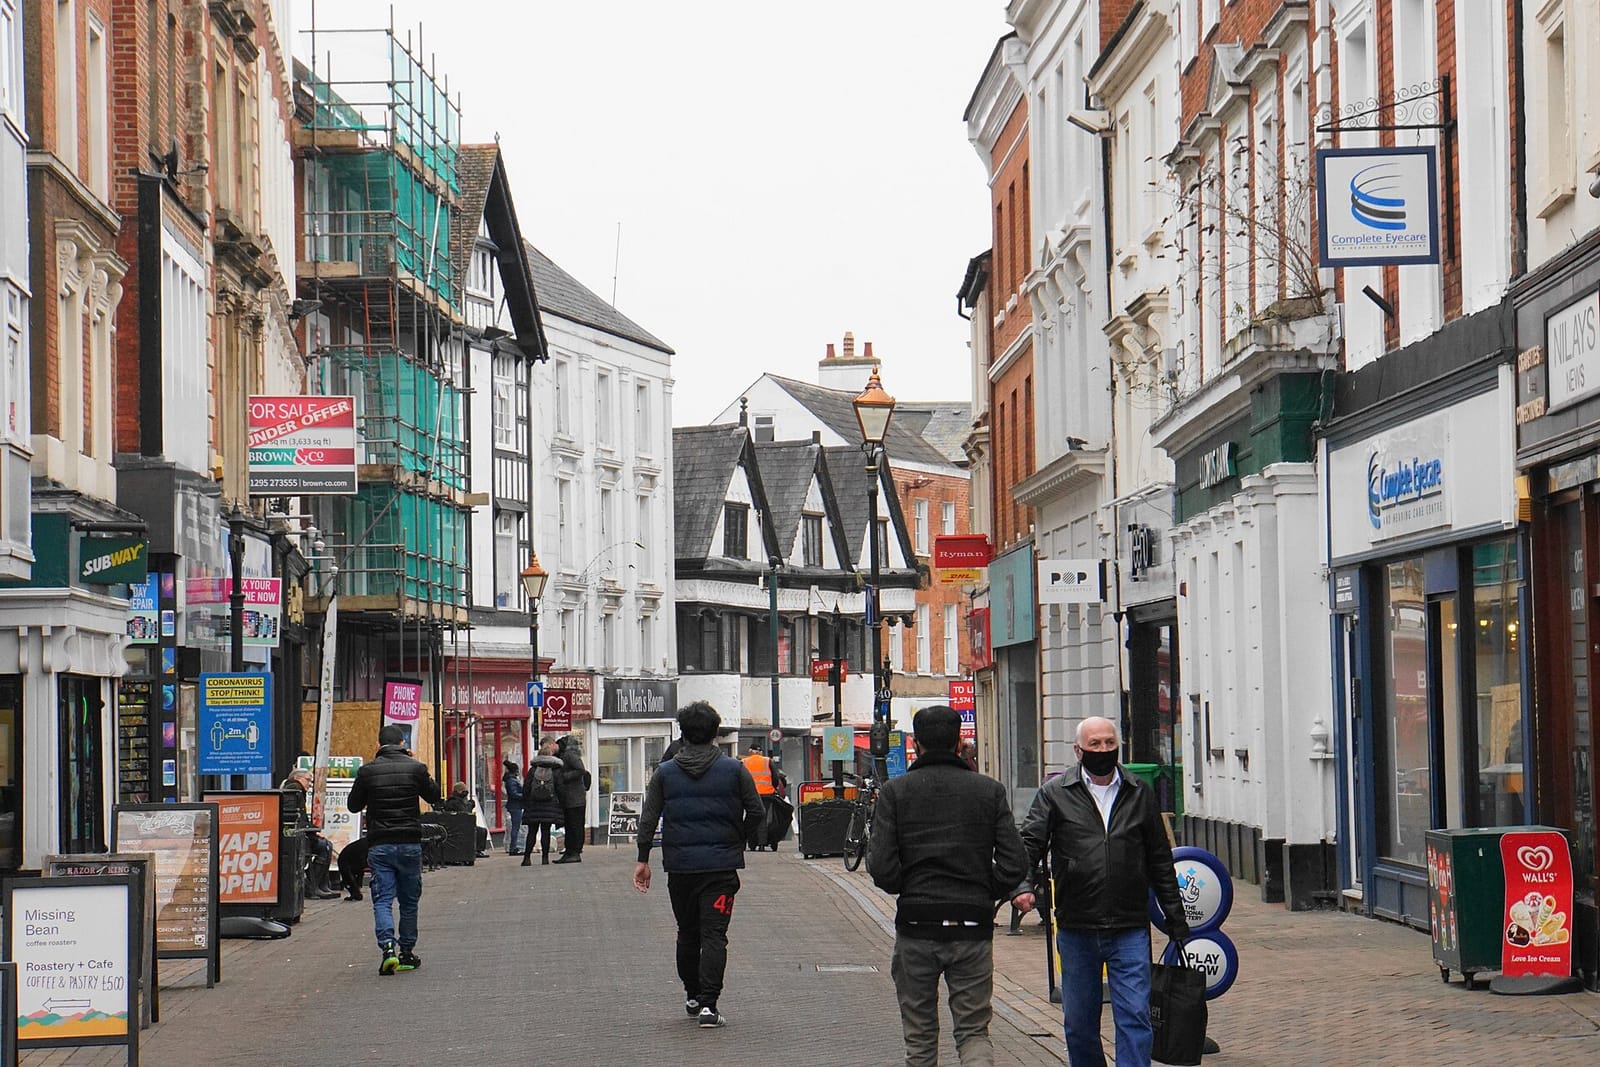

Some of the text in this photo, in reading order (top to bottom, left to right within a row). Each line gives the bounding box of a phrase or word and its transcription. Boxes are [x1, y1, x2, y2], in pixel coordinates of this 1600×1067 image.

[1331, 233, 1427, 244] Complete Eyecare
[1553, 306, 1596, 368] NILAYS
[1566, 363, 1586, 394] NEWS
[279, 403, 317, 419] SALE
[248, 400, 350, 447] UNDER OFFER
[270, 479, 298, 487] 273555
[1380, 457, 1442, 505] Complete Eyecare
[82, 543, 145, 577] SUBWAY
[939, 551, 984, 559] Ryman
[1051, 571, 1088, 584] POP
[133, 586, 147, 597] DAY
[250, 580, 271, 590] YOUR
[257, 591, 276, 602] NOW
[393, 685, 416, 700] PHONE
[473, 686, 491, 705] Heart
[491, 686, 525, 705] Foundation
[616, 688, 628, 713] The
[647, 689, 665, 712] Room
[389, 701, 417, 717] REPAIRS
[305, 757, 354, 767] W'RE
[222, 806, 241, 814] NEW
[242, 812, 261, 820] YOU
[220, 831, 271, 851] VAPE
[220, 853, 273, 873] HOP
[107, 866, 129, 874] KING
[1522, 872, 1555, 883] WALL'S
[25, 909, 76, 922] Missing
[25, 924, 59, 936] Bean
[26, 959, 114, 972] Roastery + Cafe
[1188, 953, 1220, 965] PLAY
[26, 976, 56, 988] COFFEE
[58, 976, 65, 988] &
[69, 975, 98, 990] PASTRY
